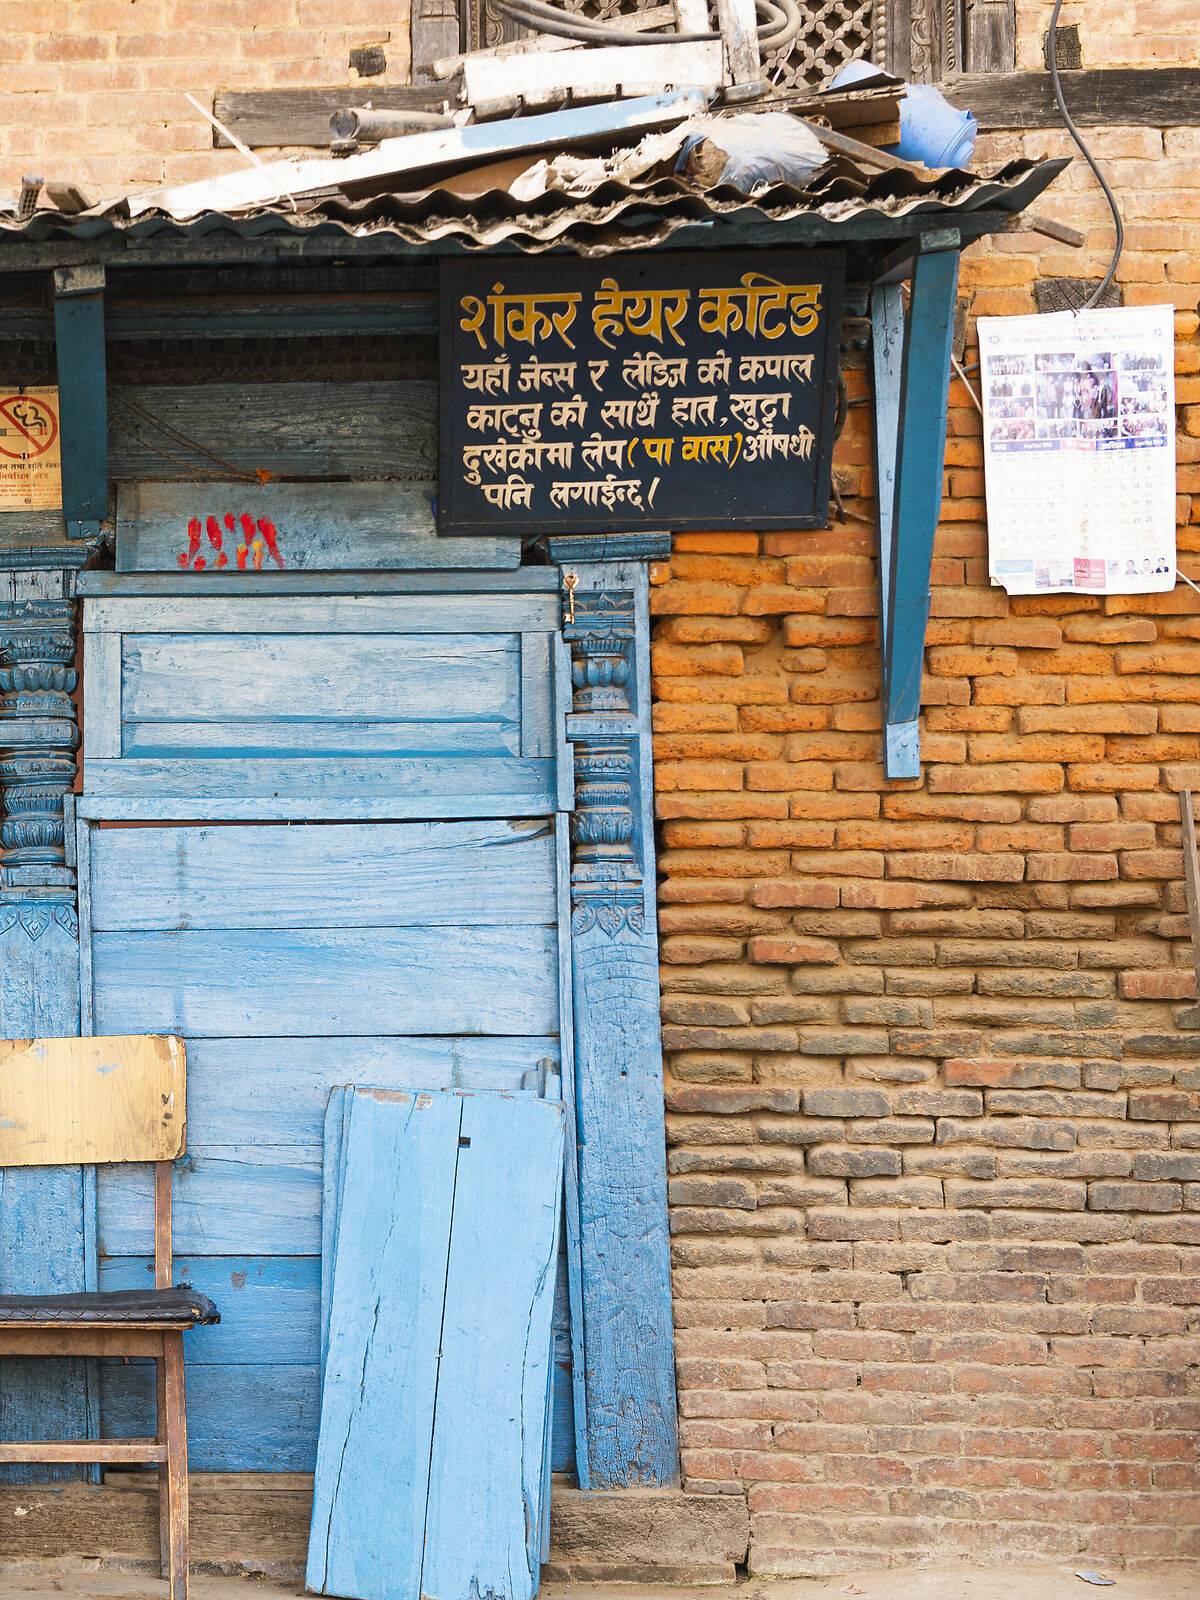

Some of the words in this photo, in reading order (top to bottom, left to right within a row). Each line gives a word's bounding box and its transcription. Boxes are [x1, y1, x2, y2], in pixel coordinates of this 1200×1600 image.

[460, 281, 582, 350] शंकर
[592, 277, 690, 350] हेयर
[698, 271, 822, 339] कटिङ
[460, 352, 511, 397] यहाँ
[517, 354, 578, 393] जेन्स
[587, 359, 609, 392] र
[621, 351, 689, 390] लेडिज
[697, 349, 732, 386] को
[738, 353, 815, 384] कपाल
[466, 402, 543, 441] काट्नु
[550, 393, 588, 430] को
[600, 391, 660, 430] साथै
[729, 392, 792, 431] खुट्टा
[480, 473, 535, 511] पनि
